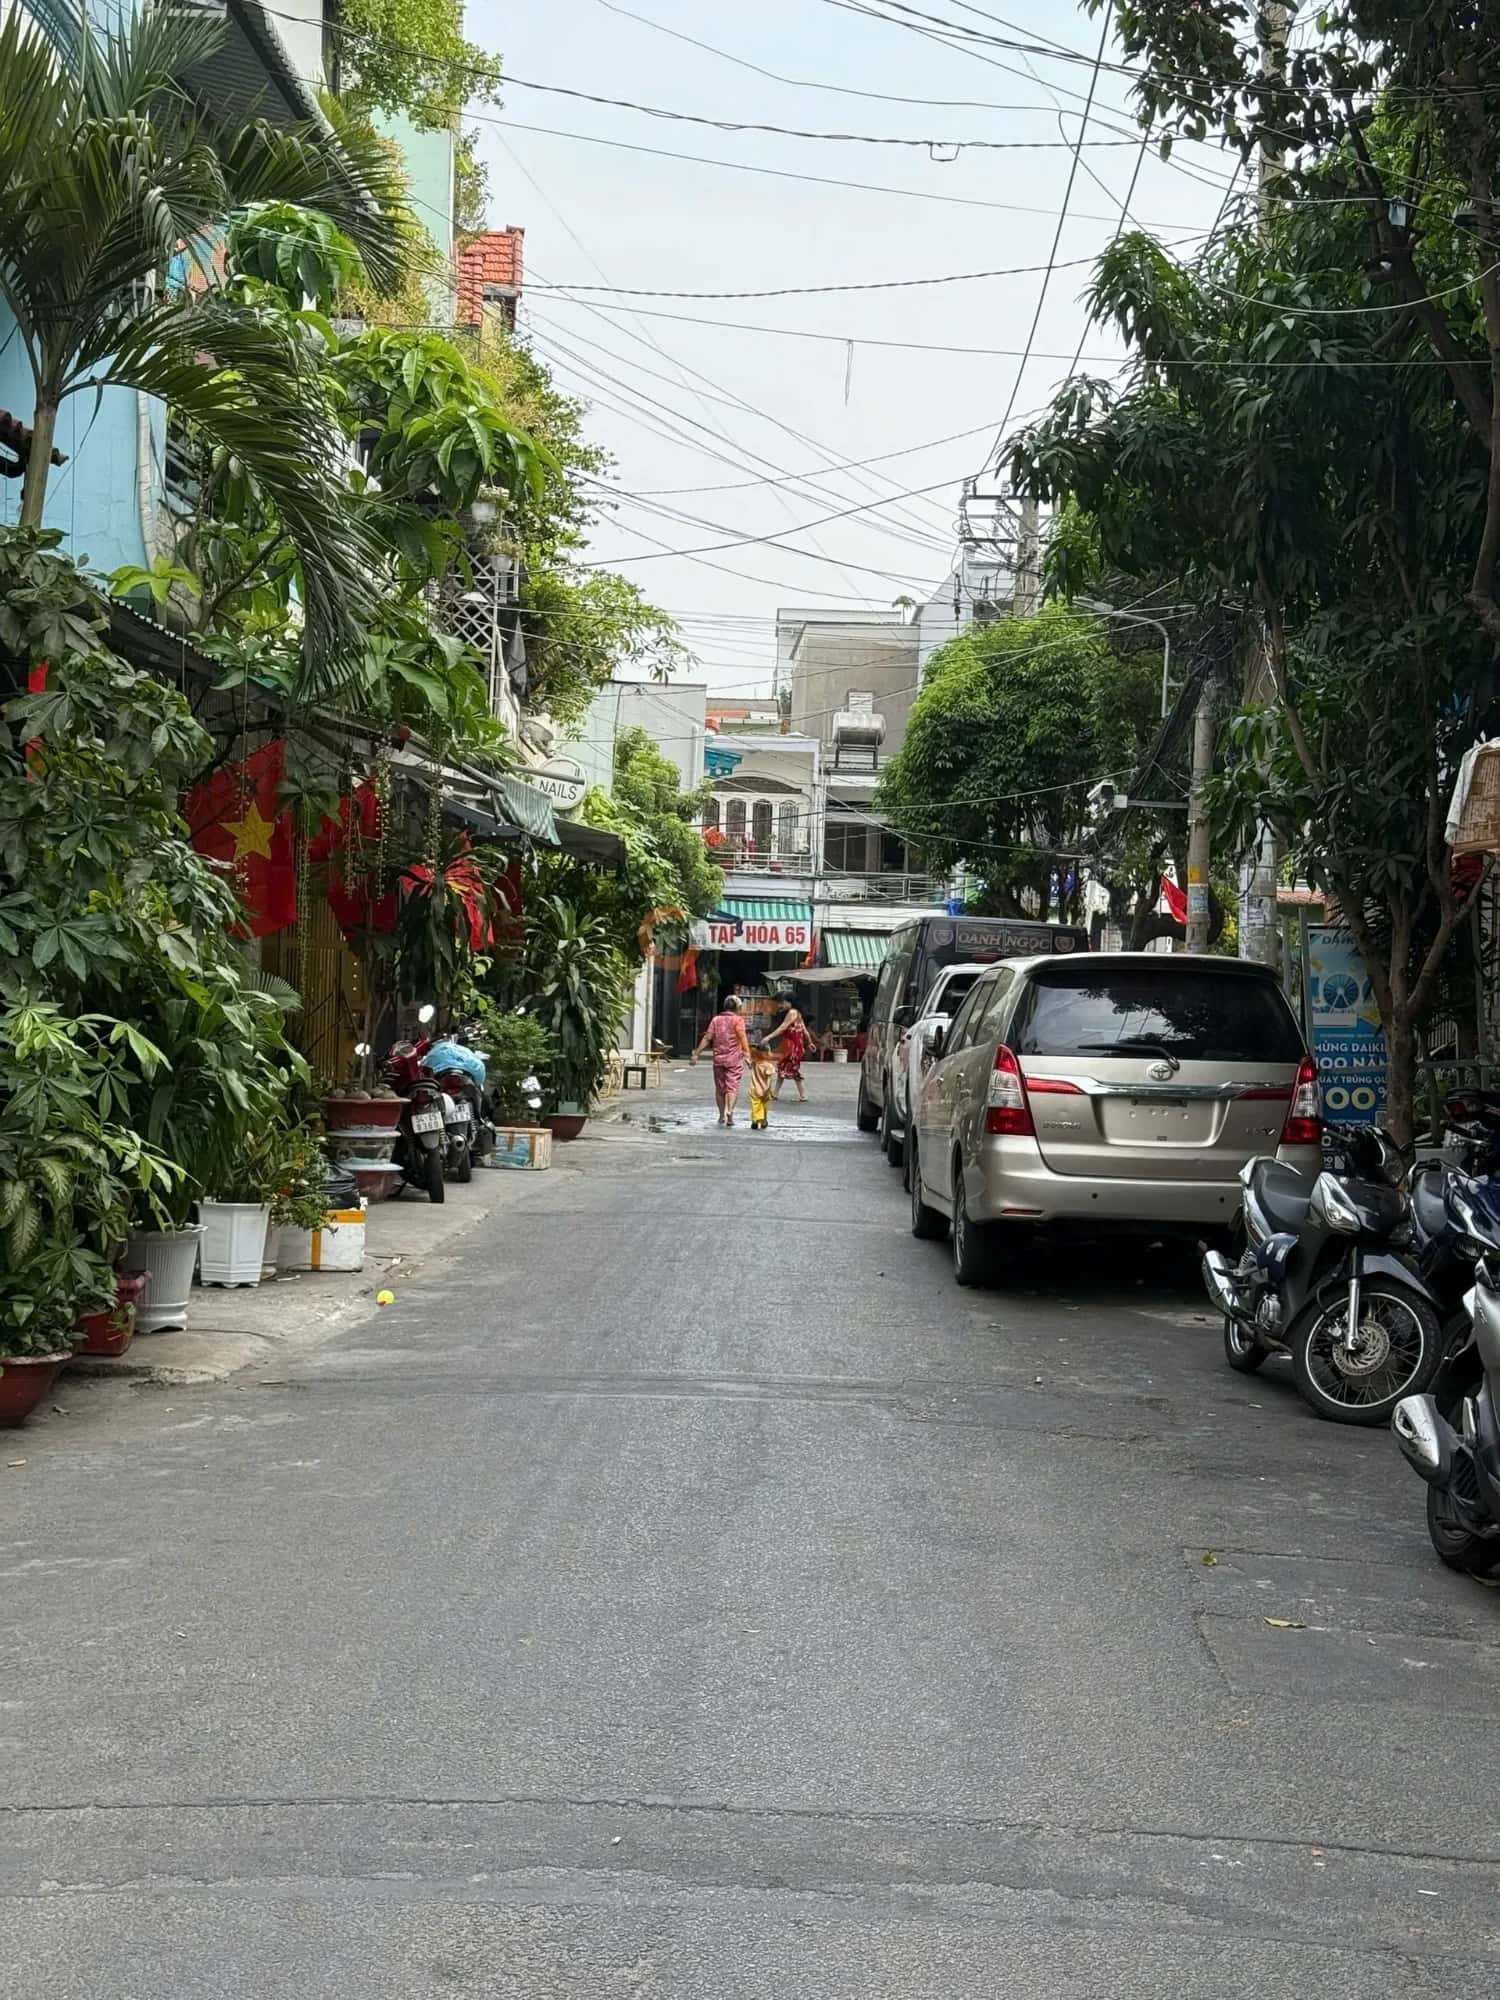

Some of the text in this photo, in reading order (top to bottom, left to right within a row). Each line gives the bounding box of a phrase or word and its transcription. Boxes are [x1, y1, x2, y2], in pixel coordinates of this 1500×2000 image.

[539, 780, 577, 801] NAILS
[785, 926, 805, 945] 65
[958, 932, 1049, 949] OANH NGỌC
[1321, 935, 1355, 945] DAIK
[1351, 1042, 1385, 1053] DAIKI
